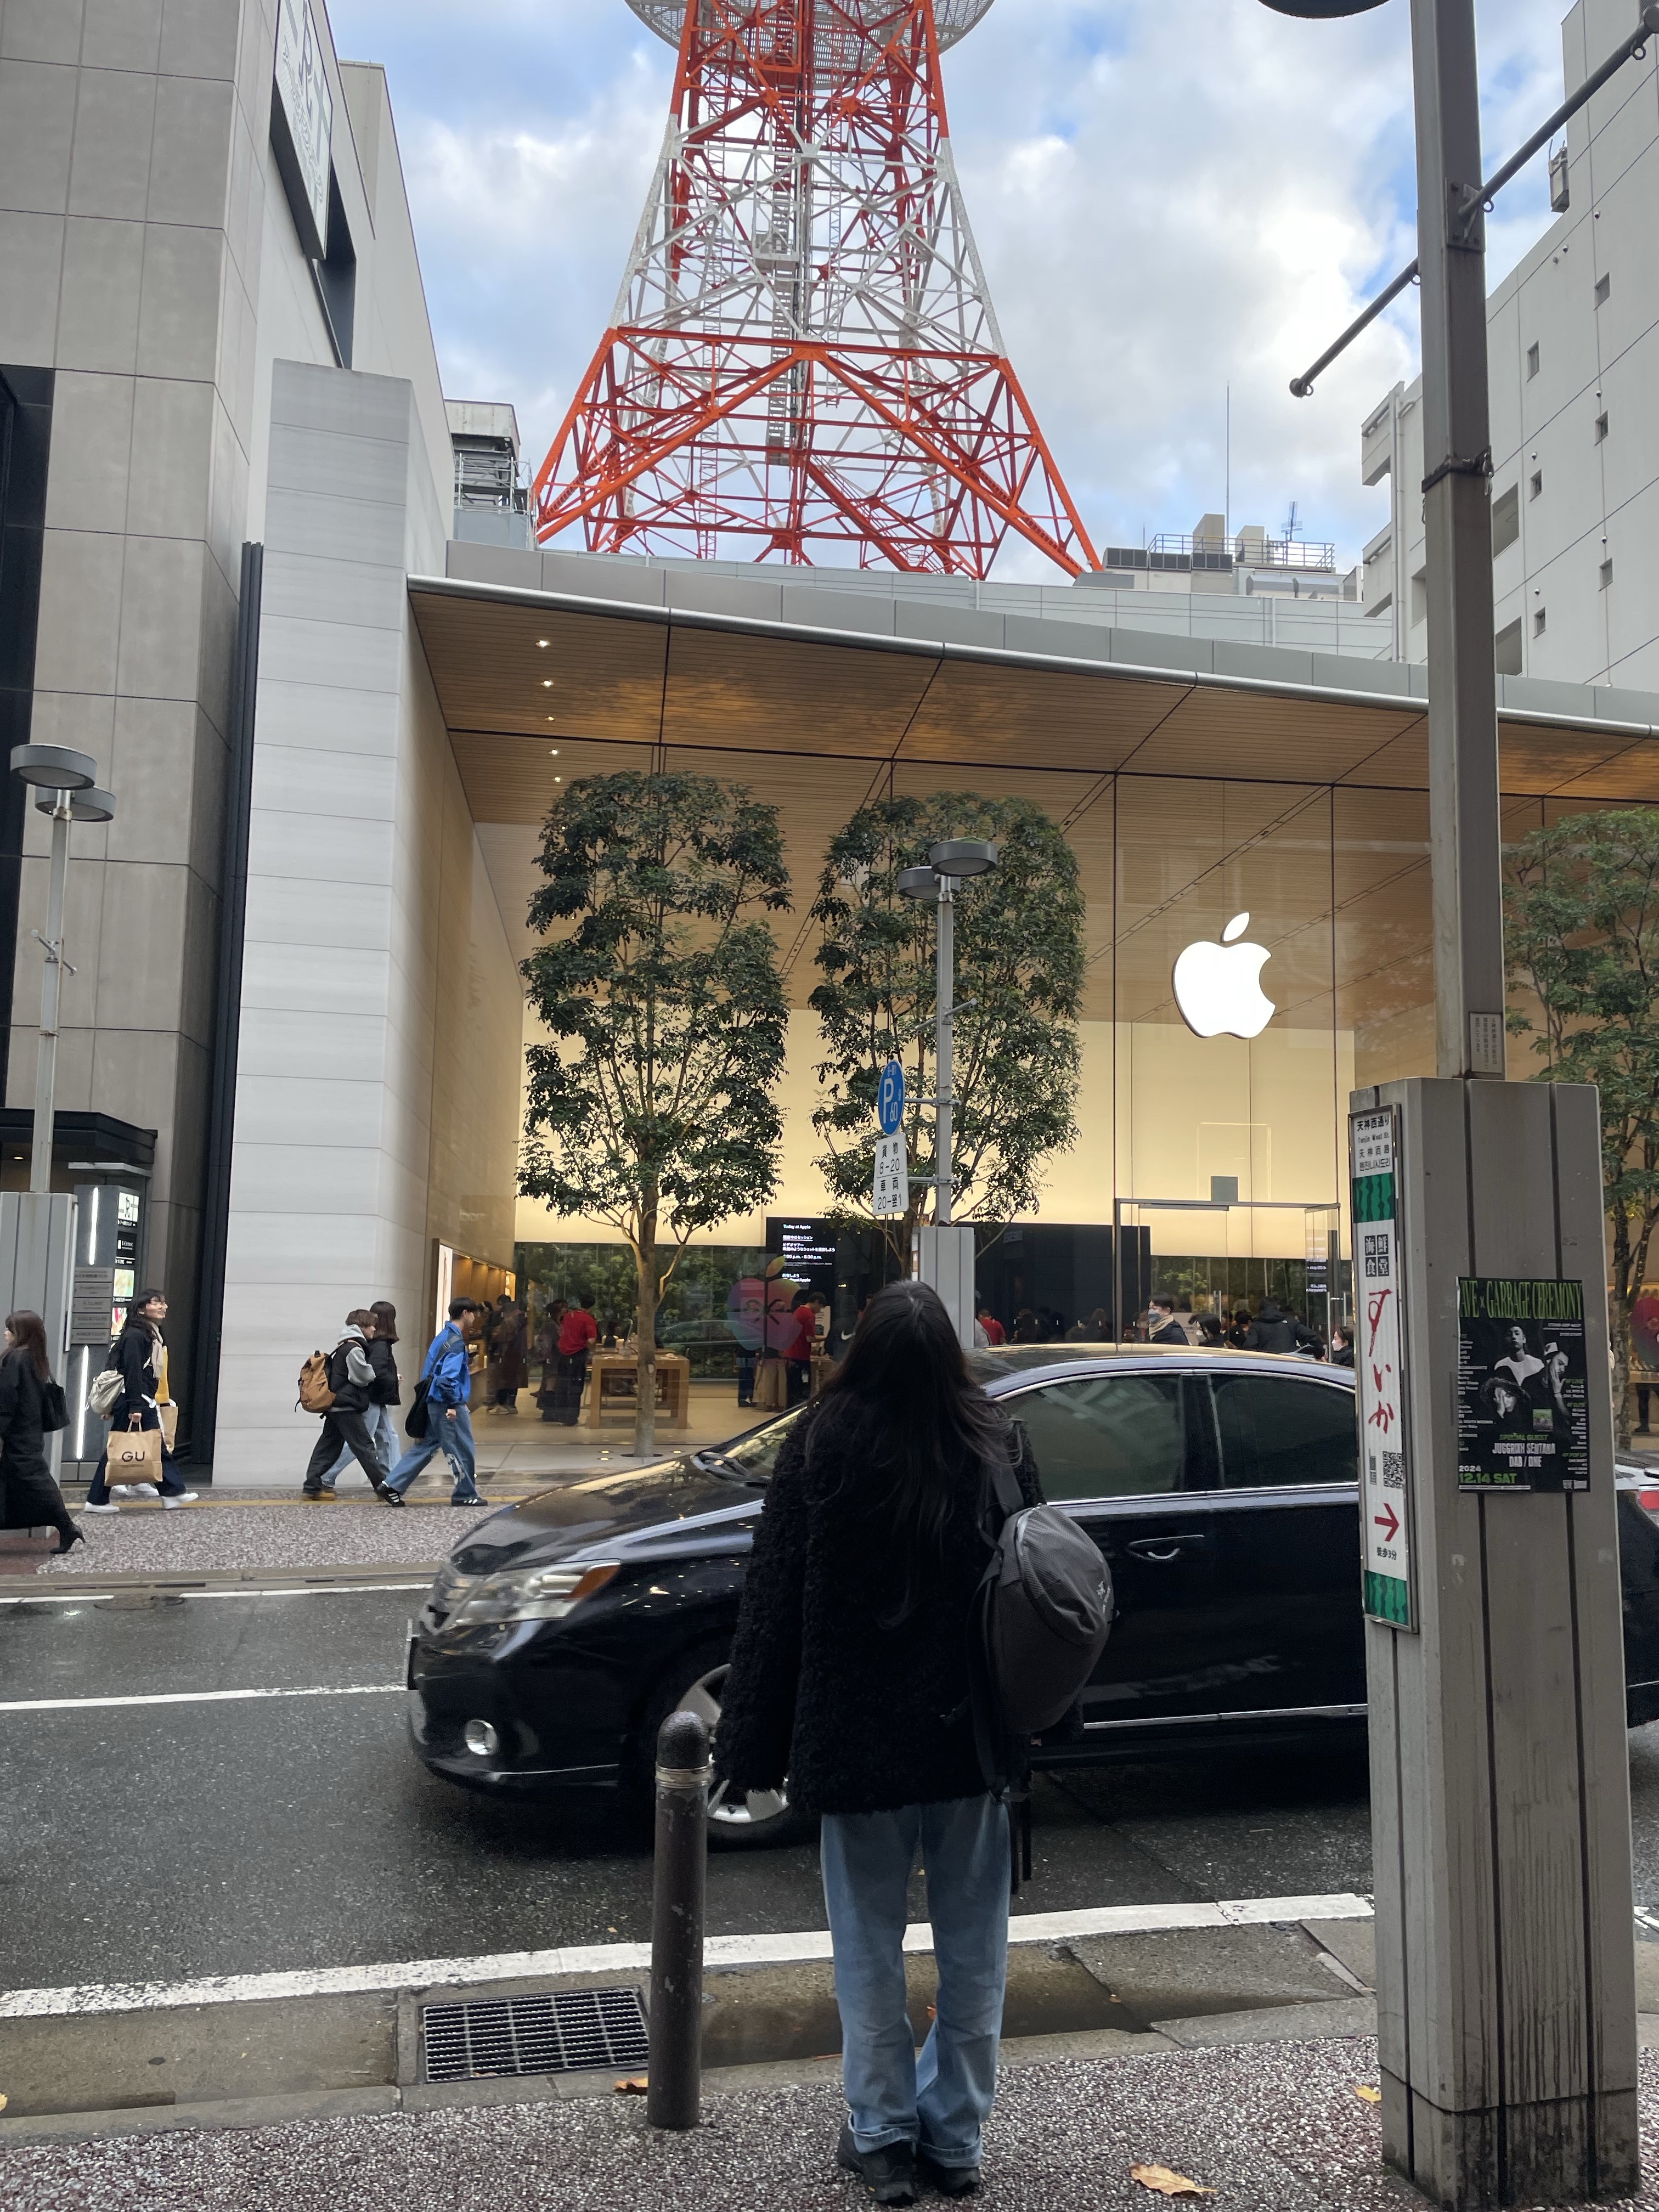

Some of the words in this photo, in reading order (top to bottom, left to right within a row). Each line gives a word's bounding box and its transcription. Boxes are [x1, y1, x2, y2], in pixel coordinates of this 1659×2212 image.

[883, 1077, 894, 1124] P
[890, 1101, 898, 1122] 60
[1357, 1114, 1389, 1132] 天神西通り
[880, 1177, 899, 1193] 車両
[1368, 1289, 1395, 1435] すいか
[121, 1451, 145, 1462] GU
[1459, 1472, 1491, 1484] 12.14
[1493, 1472, 1517, 1484] SAT
[1376, 1547, 1397, 1560] 徒歩3分
